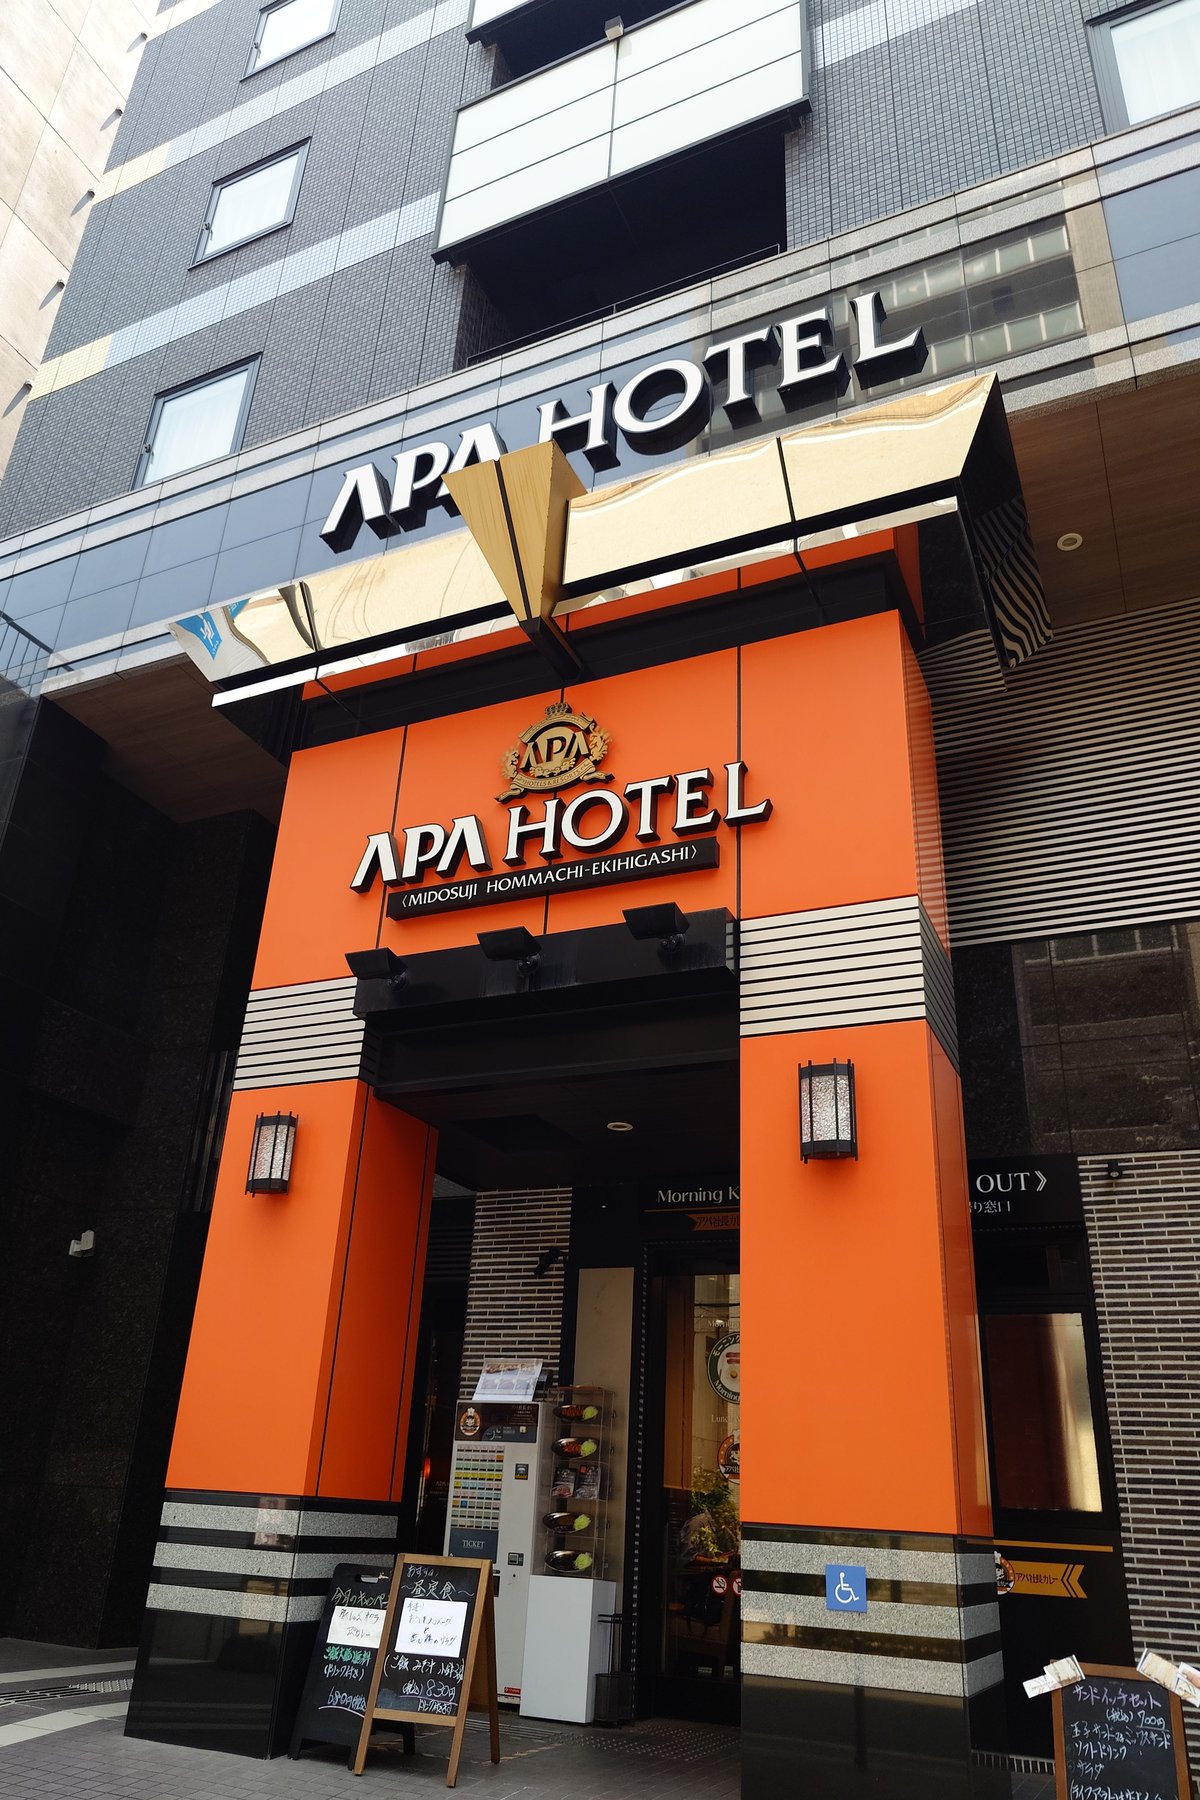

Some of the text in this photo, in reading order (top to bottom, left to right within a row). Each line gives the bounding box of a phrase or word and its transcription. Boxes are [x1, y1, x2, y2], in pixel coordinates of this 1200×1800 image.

[536, 290, 924, 458] HOTEL
[349, 760, 773, 893] APA HOTEL
[975, 1171, 1031, 1194] OUT
[657, 1187, 723, 1204] Morning
[462, 1539, 486, 1549] TICKET
[1076, 1759, 1105, 1781] サラダ
